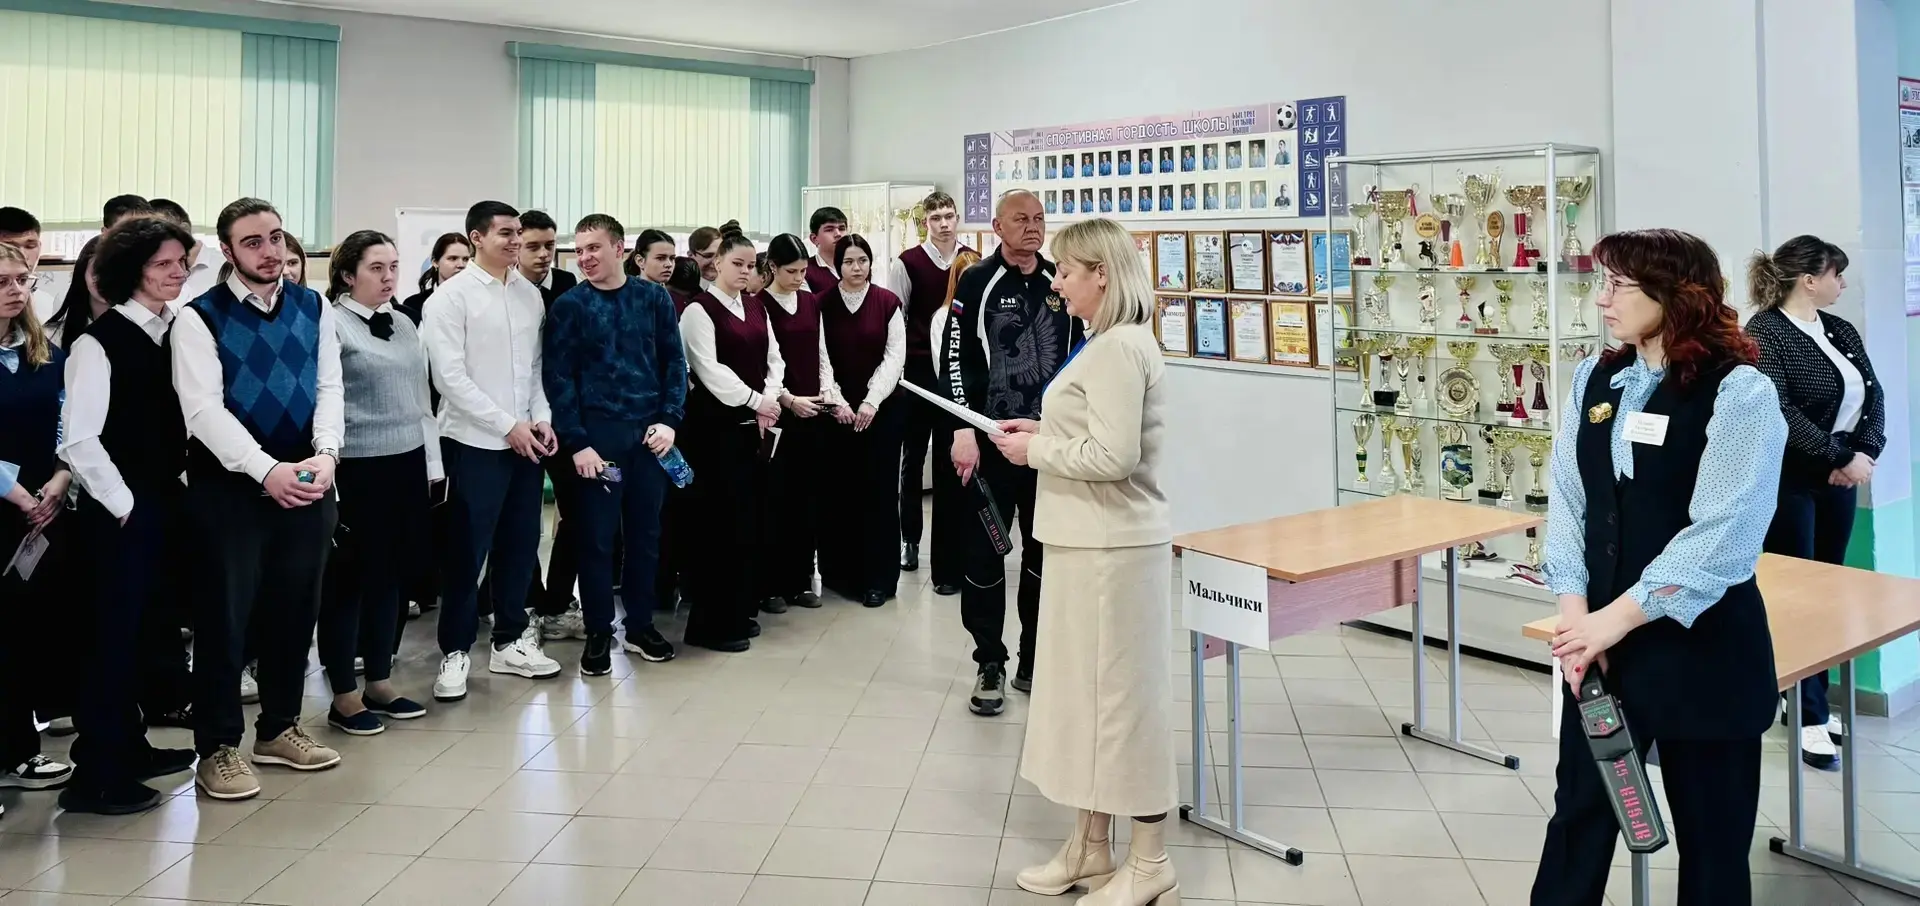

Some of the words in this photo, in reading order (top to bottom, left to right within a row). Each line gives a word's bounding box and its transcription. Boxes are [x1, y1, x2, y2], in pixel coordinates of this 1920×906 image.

[1046, 127, 1113, 147] СПОРТИВНАЯ
[1117, 121, 1179, 140] ГОРДОСТЬ
[1182, 116, 1230, 136] ШКОЛЫ
[948, 316, 961, 359] TEAM
[1188, 580, 1263, 613] Мальчики
